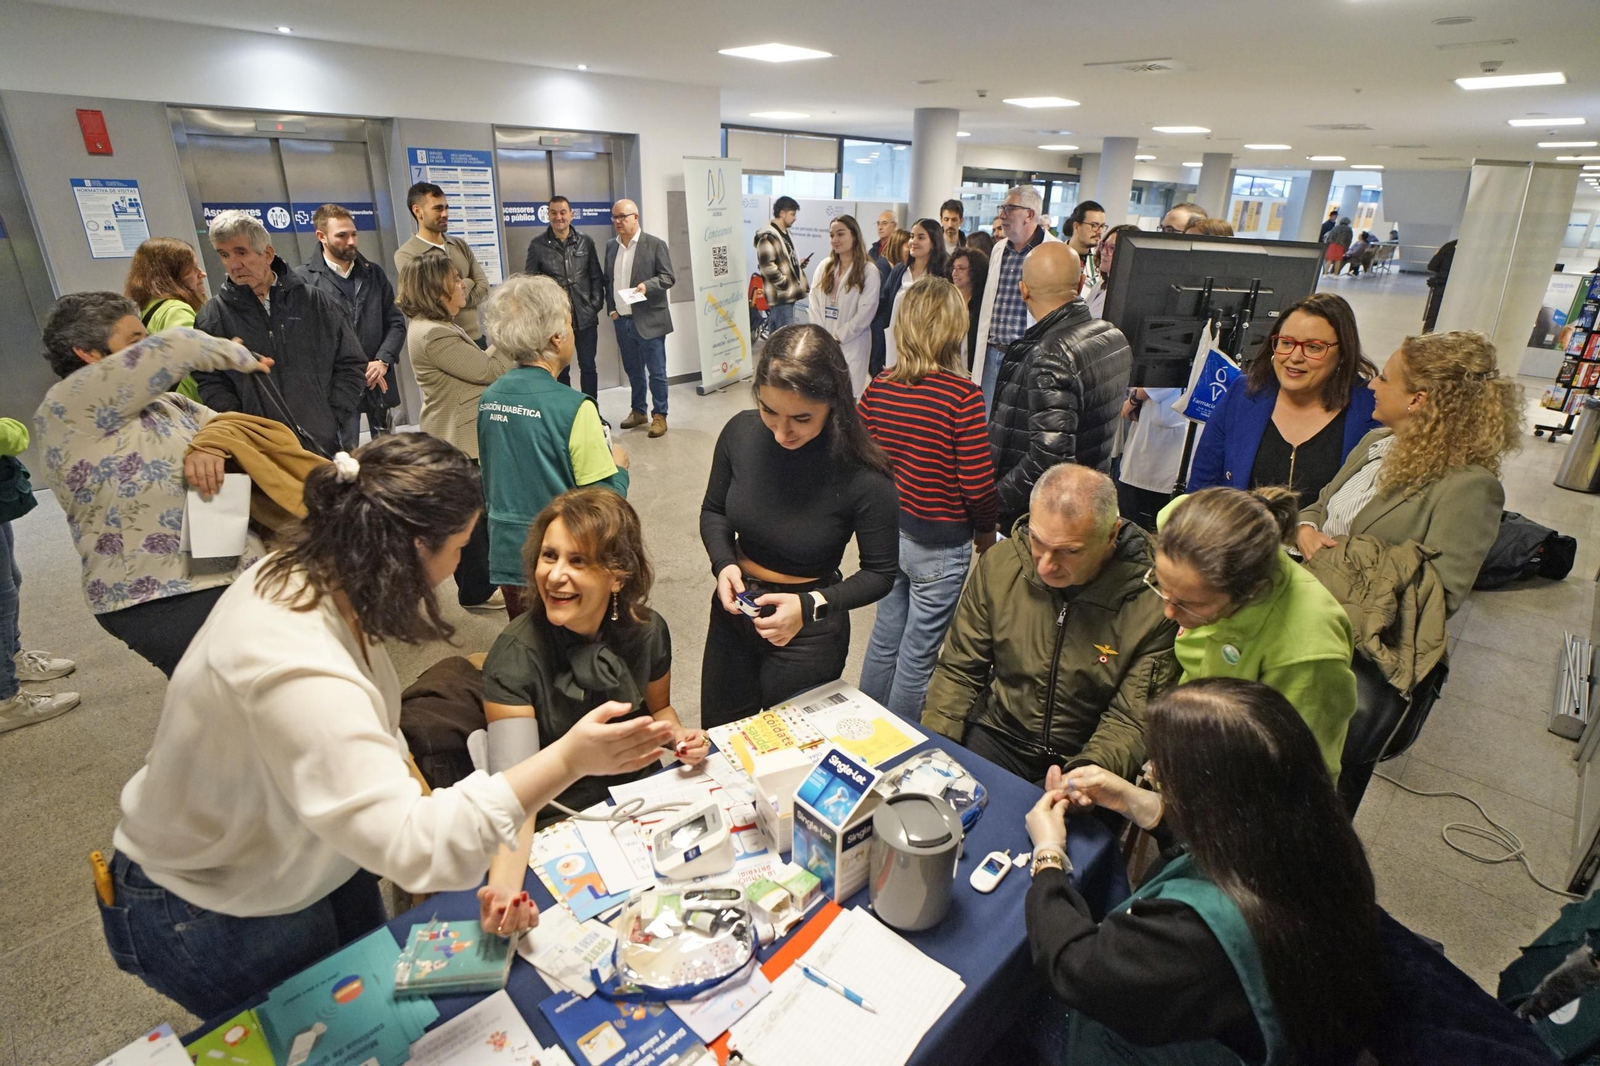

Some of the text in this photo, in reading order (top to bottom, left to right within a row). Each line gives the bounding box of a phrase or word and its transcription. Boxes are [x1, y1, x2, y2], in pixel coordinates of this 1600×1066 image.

[415, 168, 422, 177] 7
[512, 214, 535, 223] público
[502, 404, 541, 418] DIABÉTICA
[762, 713, 794, 747] Cóidate
[829, 755, 867, 786] Single-Let
[797, 810, 832, 843] Single-Let
